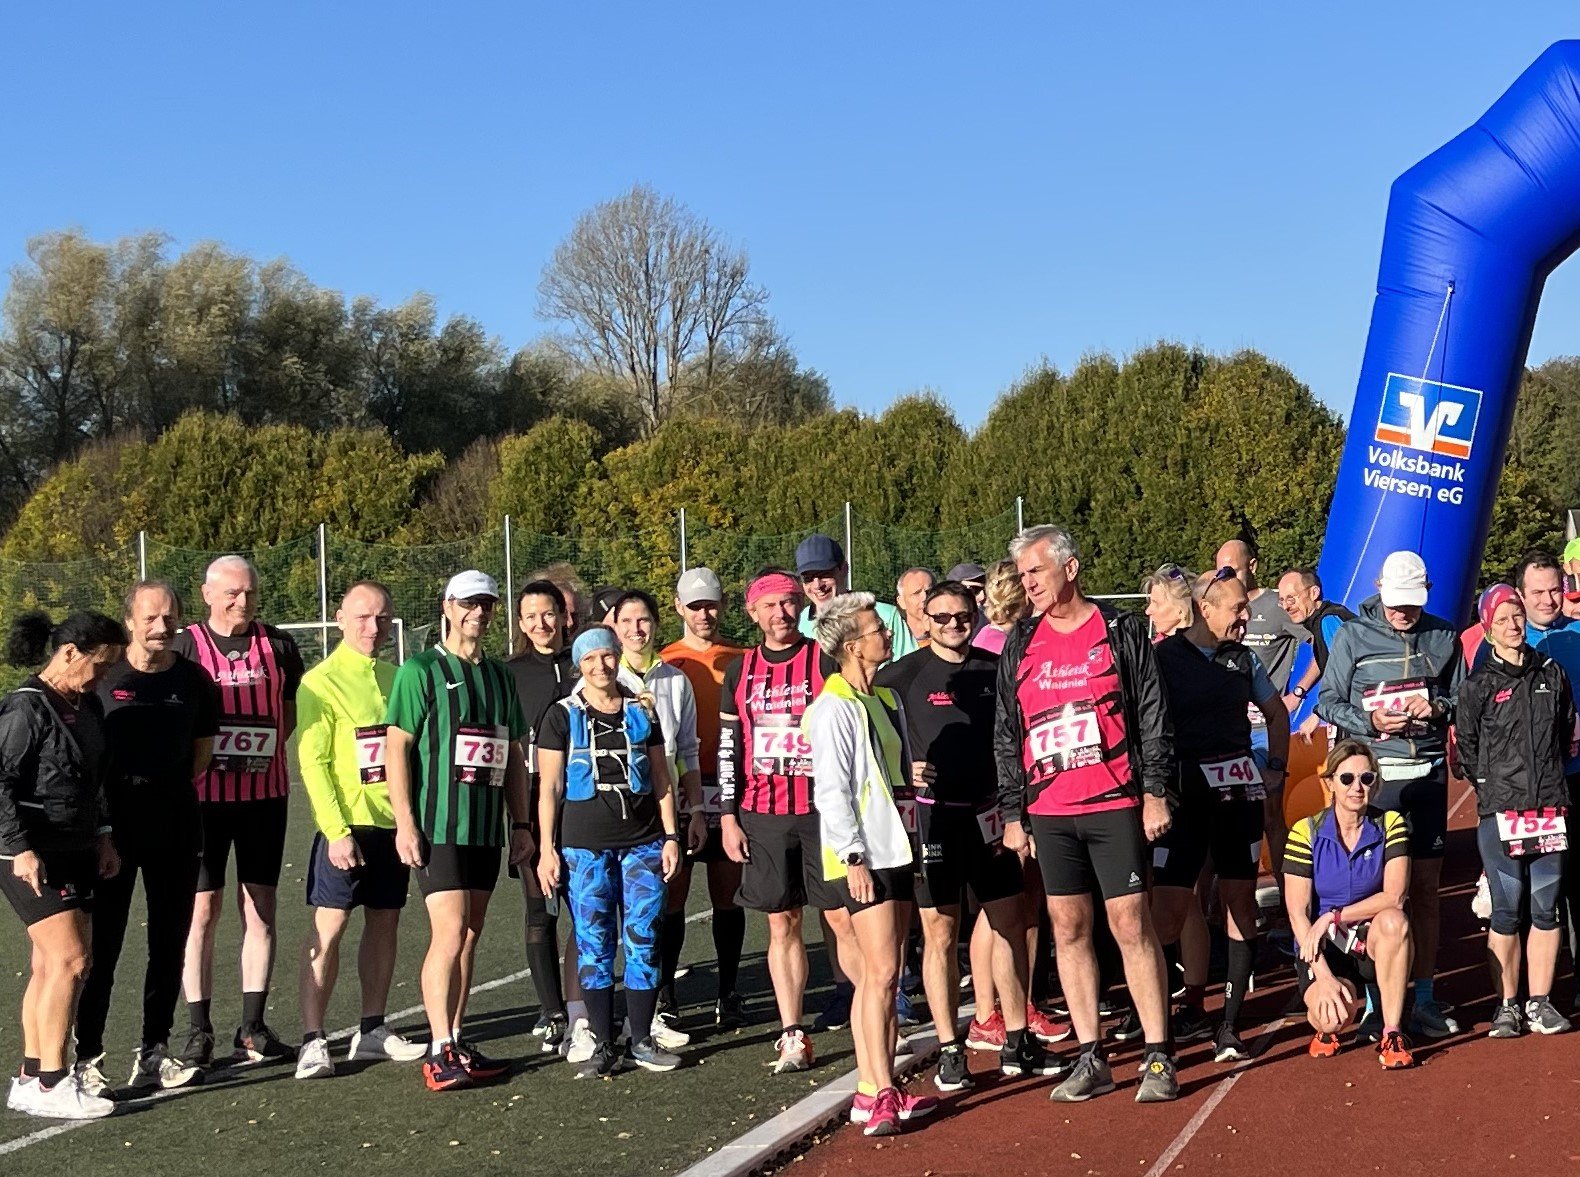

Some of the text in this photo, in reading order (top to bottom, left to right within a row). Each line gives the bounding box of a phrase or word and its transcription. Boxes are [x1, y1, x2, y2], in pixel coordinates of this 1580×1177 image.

[1368, 445, 1466, 482] Volksbank
[1363, 468, 1464, 505] Viersen eG
[219, 731, 270, 752] 767
[761, 732, 812, 754] 749
[1036, 719, 1088, 752] 757
[464, 741, 504, 764] 735
[1505, 811, 1557, 835] 752
